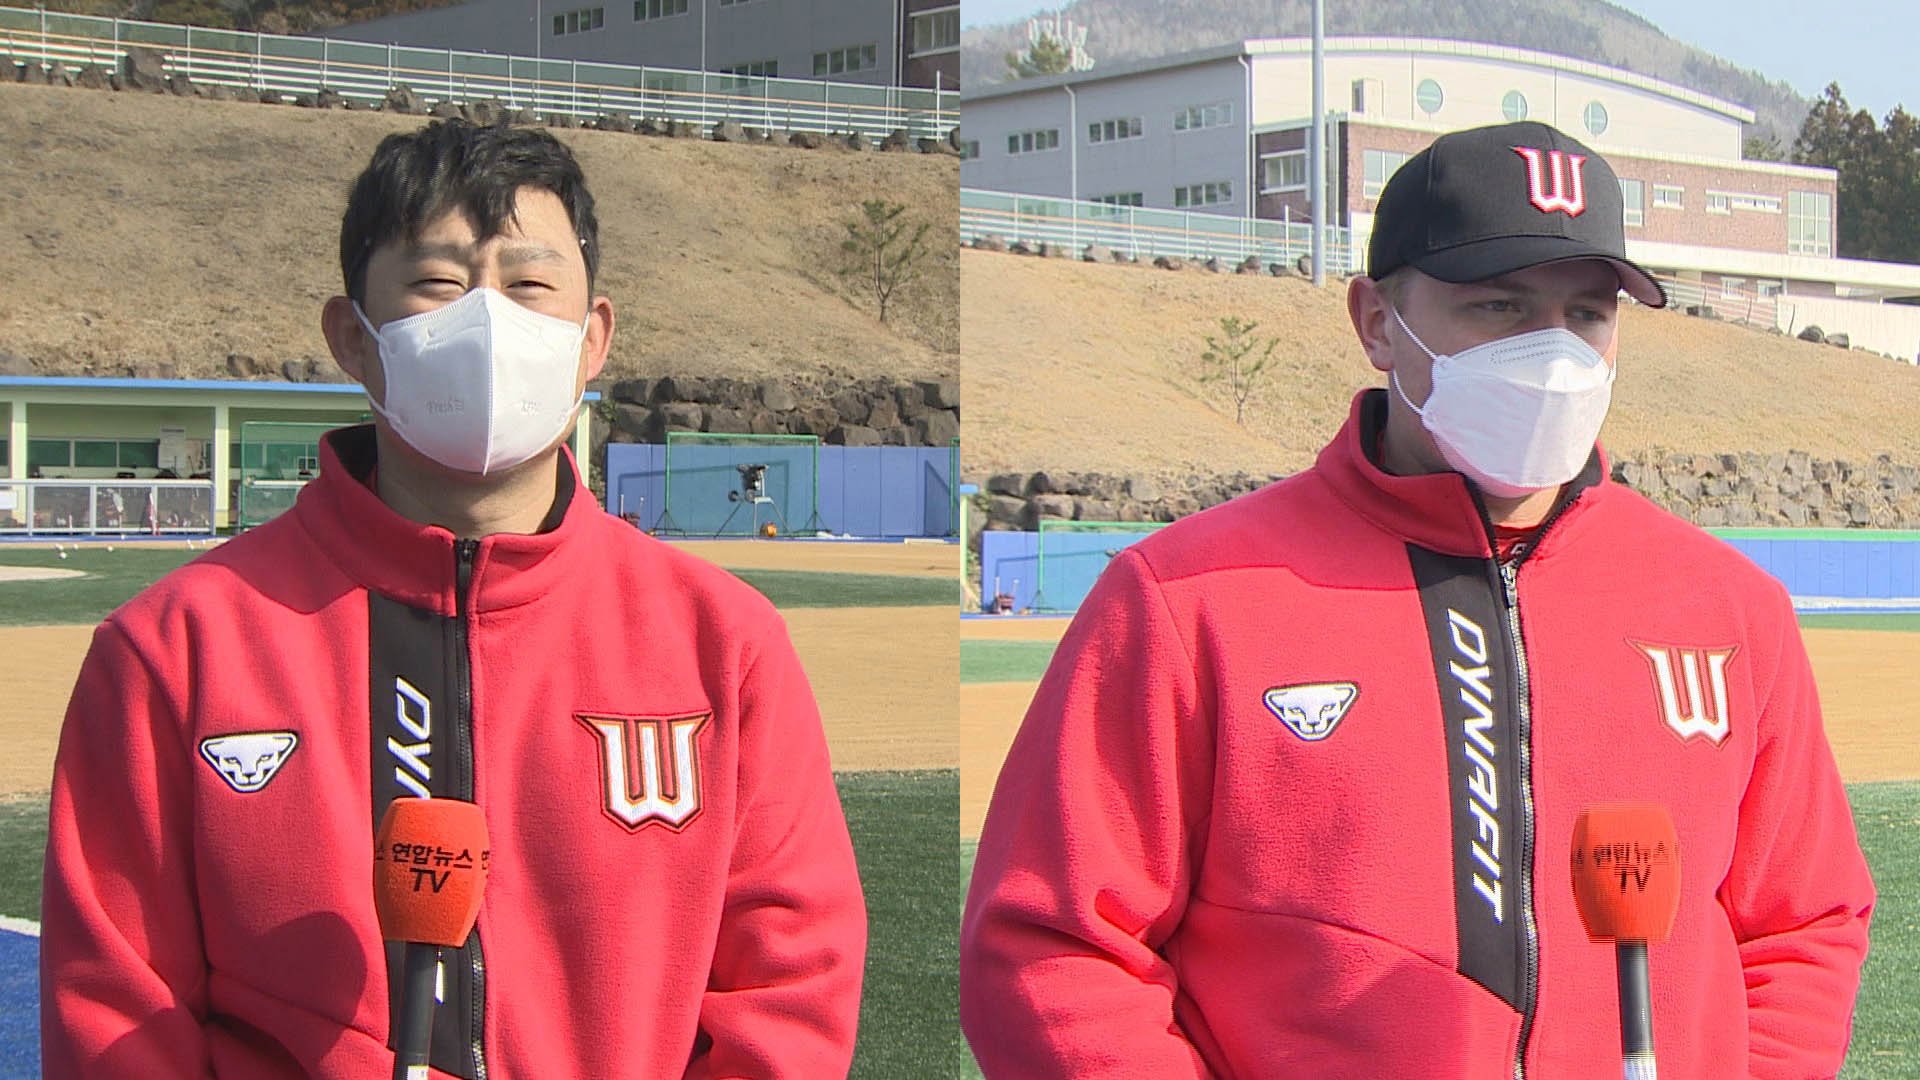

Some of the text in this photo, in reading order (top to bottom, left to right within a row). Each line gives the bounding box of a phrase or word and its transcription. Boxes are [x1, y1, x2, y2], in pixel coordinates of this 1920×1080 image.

[1510, 145, 1588, 218] W
[1627, 638, 1740, 748] W
[574, 711, 712, 833] W
[1447, 608, 1503, 925] DYNAFIT
[392, 843, 473, 869] 연합뉴스
[409, 867, 451, 894] TV
[1593, 841, 1669, 869] 연합뉴스
[1614, 864, 1652, 893] TV
